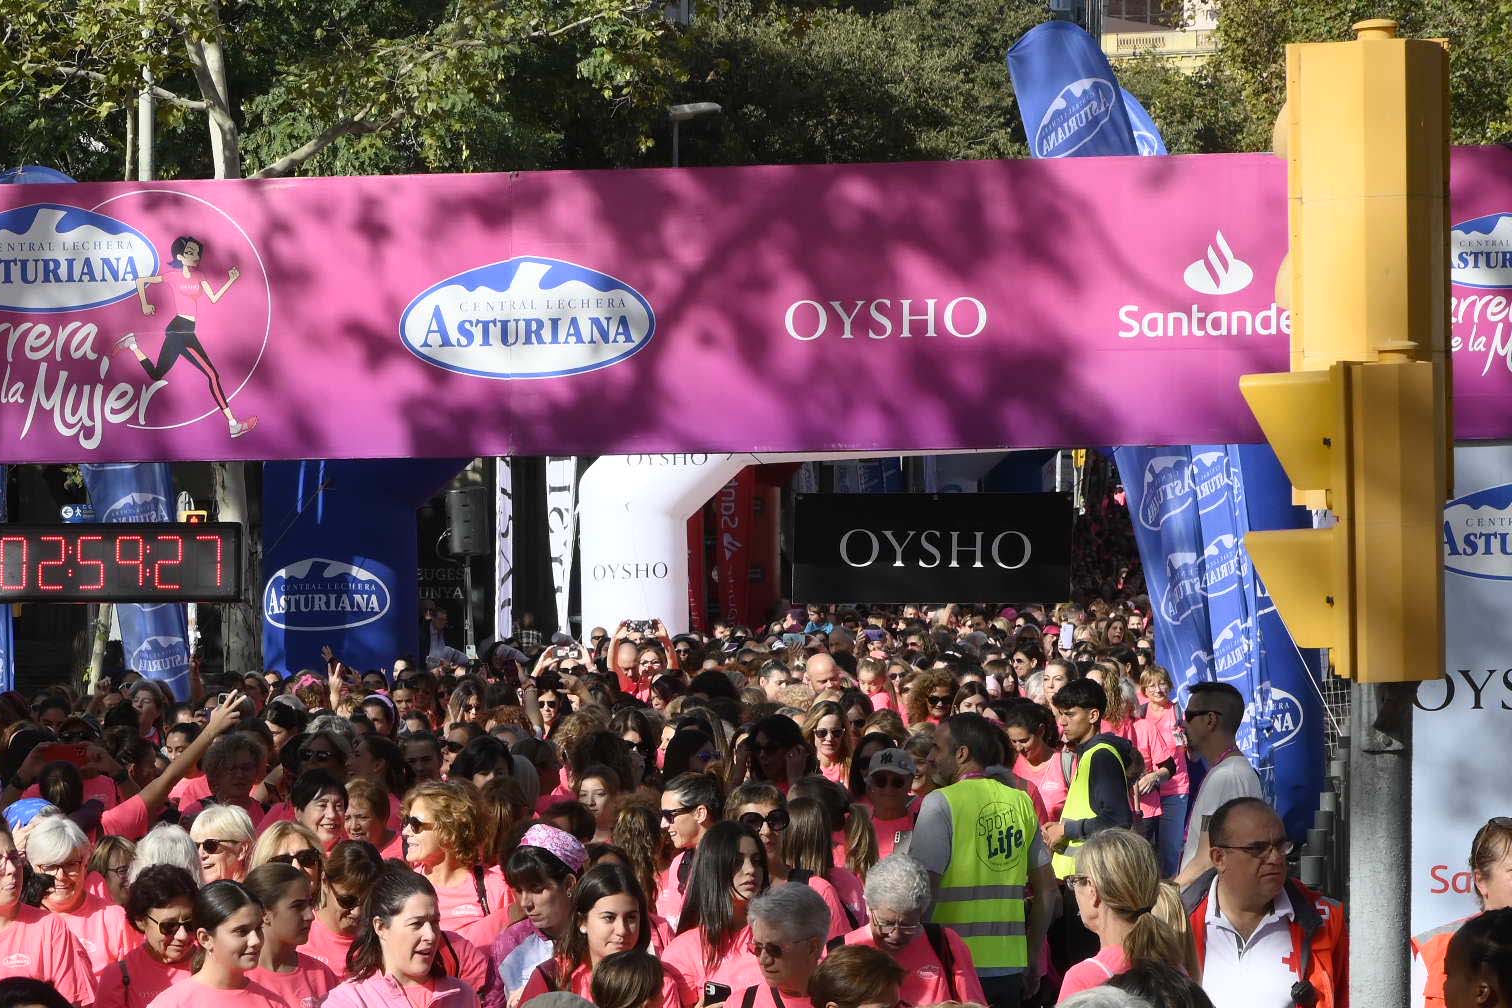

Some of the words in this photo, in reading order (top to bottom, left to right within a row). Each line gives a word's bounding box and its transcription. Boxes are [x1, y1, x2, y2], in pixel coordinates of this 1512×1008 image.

[62, 240, 134, 251] LECHERA
[459, 300, 537, 312] CENTRAL
[545, 298, 628, 310] LECHERA
[784, 297, 988, 341] OYSHO
[1117, 302, 1293, 339] Santande
[420, 304, 635, 349] ASTURIANA
[1468, 324, 1487, 352] la
[0, 365, 25, 404] la
[20, 356, 169, 450] Mujer
[0, 534, 224, 591] 02:59:27
[839, 528, 1033, 570] OYSHO
[593, 561, 668, 582] OYSHO
[268, 586, 381, 616] ASTURIANA
[977, 807, 1016, 837] Sport
[986, 825, 1024, 860] Life
